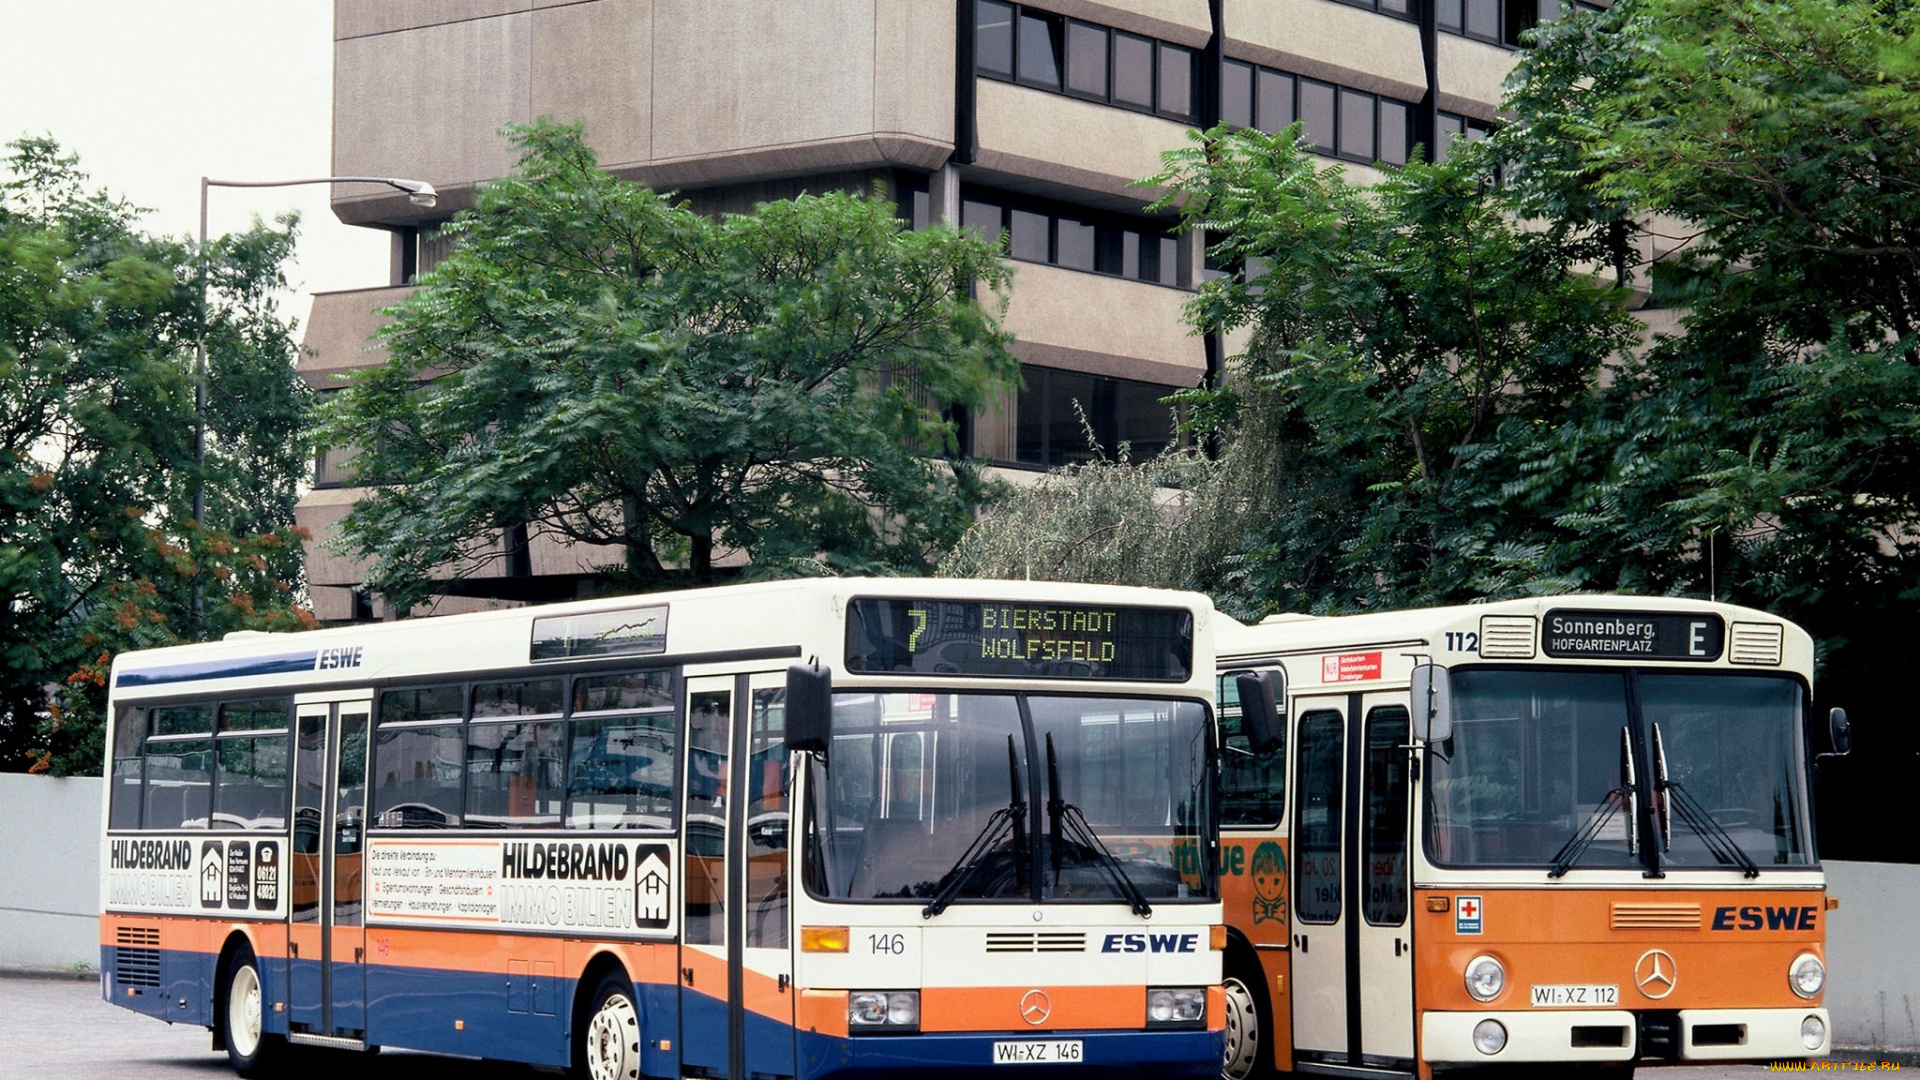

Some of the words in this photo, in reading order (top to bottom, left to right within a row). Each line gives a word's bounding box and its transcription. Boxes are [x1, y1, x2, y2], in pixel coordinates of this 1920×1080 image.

[908, 609, 926, 652] 7
[982, 607, 1116, 632] BIERSTADT
[982, 637, 1116, 662] WOLFSFELD
[1445, 632, 1478, 652] 112
[1552, 638, 1653, 652] HOFGARTENPLATZ
[1689, 622, 1707, 656] E
[318, 645, 364, 670] ESWE
[111, 840, 192, 870] HILDEBRAND
[501, 842, 630, 881] HILDEBRAND
[109, 873, 193, 908] IMMOBILIEN
[501, 884, 632, 929] IMMOBILIEN
[1711, 906, 1819, 931] ESWE
[868, 933, 905, 955] 146
[1100, 933, 1199, 953] ESWE
[1594, 987, 1615, 1003] 112
[1056, 1043, 1079, 1060] 146
